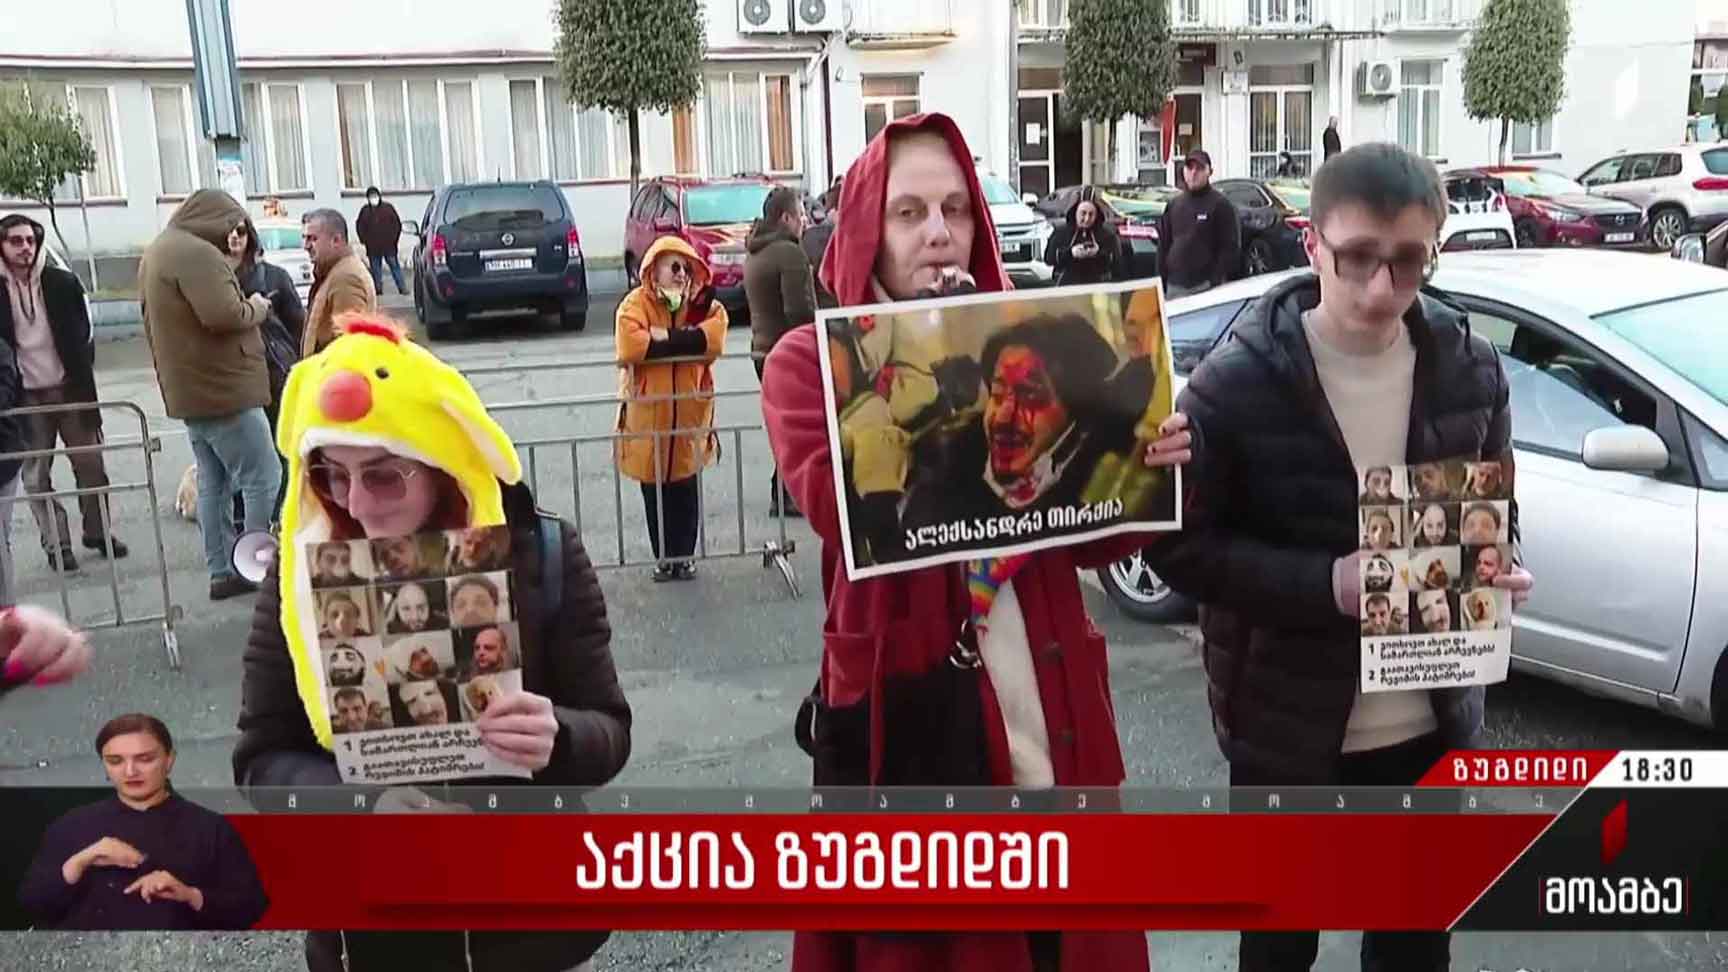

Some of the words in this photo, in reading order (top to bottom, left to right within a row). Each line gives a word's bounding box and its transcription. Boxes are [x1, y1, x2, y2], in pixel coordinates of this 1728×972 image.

[904, 510, 1043, 550] ალექსანდრე
[1047, 497, 1123, 528] თირქია
[1369, 644, 1375, 655] 1
[1369, 670, 1375, 681] 2
[344, 741, 352, 752] 1
[349, 767, 356, 777] 2
